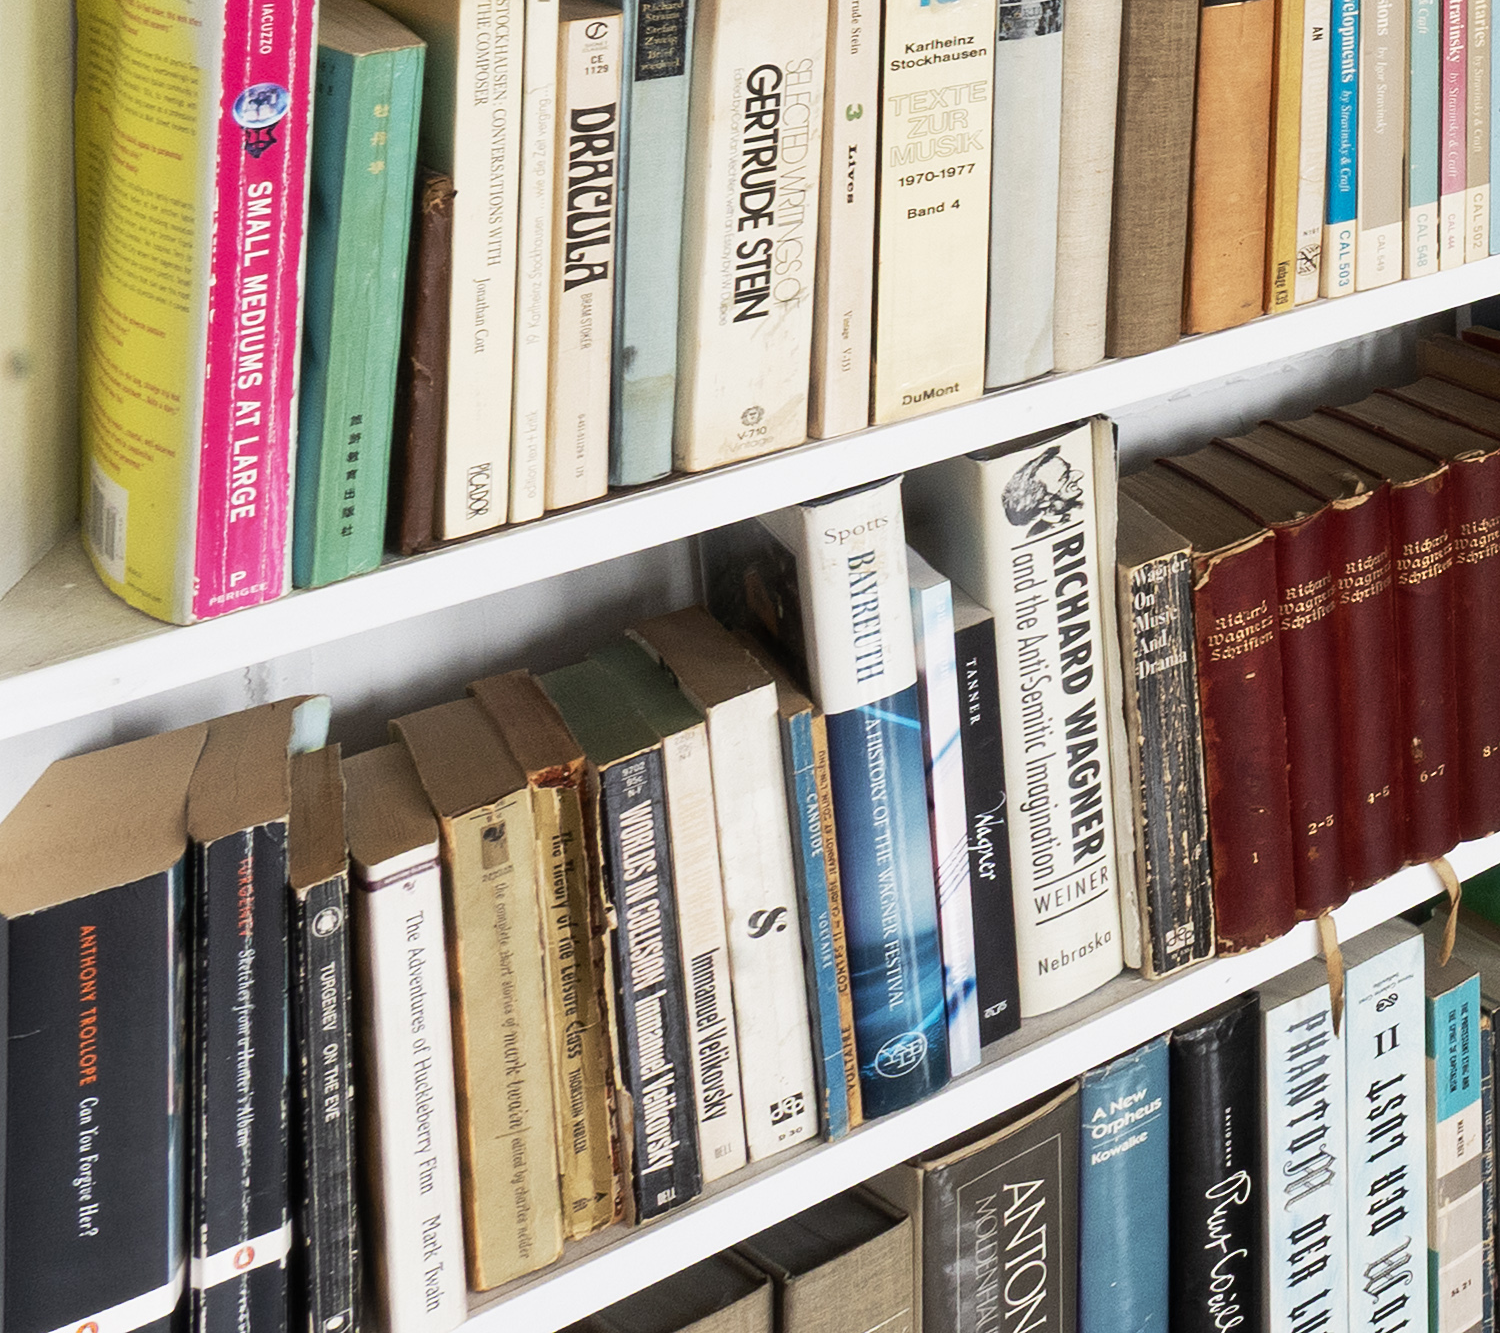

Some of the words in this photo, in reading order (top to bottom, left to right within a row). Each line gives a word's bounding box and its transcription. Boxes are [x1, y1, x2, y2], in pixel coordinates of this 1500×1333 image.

[259, 5, 275, 57] IACUZZO
[904, 33, 976, 58] Karlheinz
[890, 45, 988, 72] Stockhausen
[741, 62, 782, 220] GERTRUDE
[564, 102, 616, 293] DRACULA
[897, 163, 976, 189] 1970-1977
[244, 180, 274, 256] SMALL
[907, 203, 945, 221] Band
[949, 198, 962, 213] 4
[733, 225, 772, 325] STEIN
[240, 274, 270, 389] MEDIUMS
[234, 401, 264, 424] AT
[901, 381, 960, 407] DuMont
[230, 430, 260, 524] LARGE
[823, 512, 889, 545] Spotts
[208, 581, 268, 606] PERIGEE
[847, 549, 884, 685] BAYREUTH
[1053, 531, 1092, 695] RICHARD
[1064, 697, 1105, 866] WAGNER
[1034, 866, 1109, 916] WEINER
[81, 925, 95, 1003] ANTHONY
[1038, 930, 1112, 977] Nebraska
[80, 1008, 98, 1087] TROLLOPE
[422, 1213, 442, 1261] Mark
[425, 1265, 441, 1314] Twain
